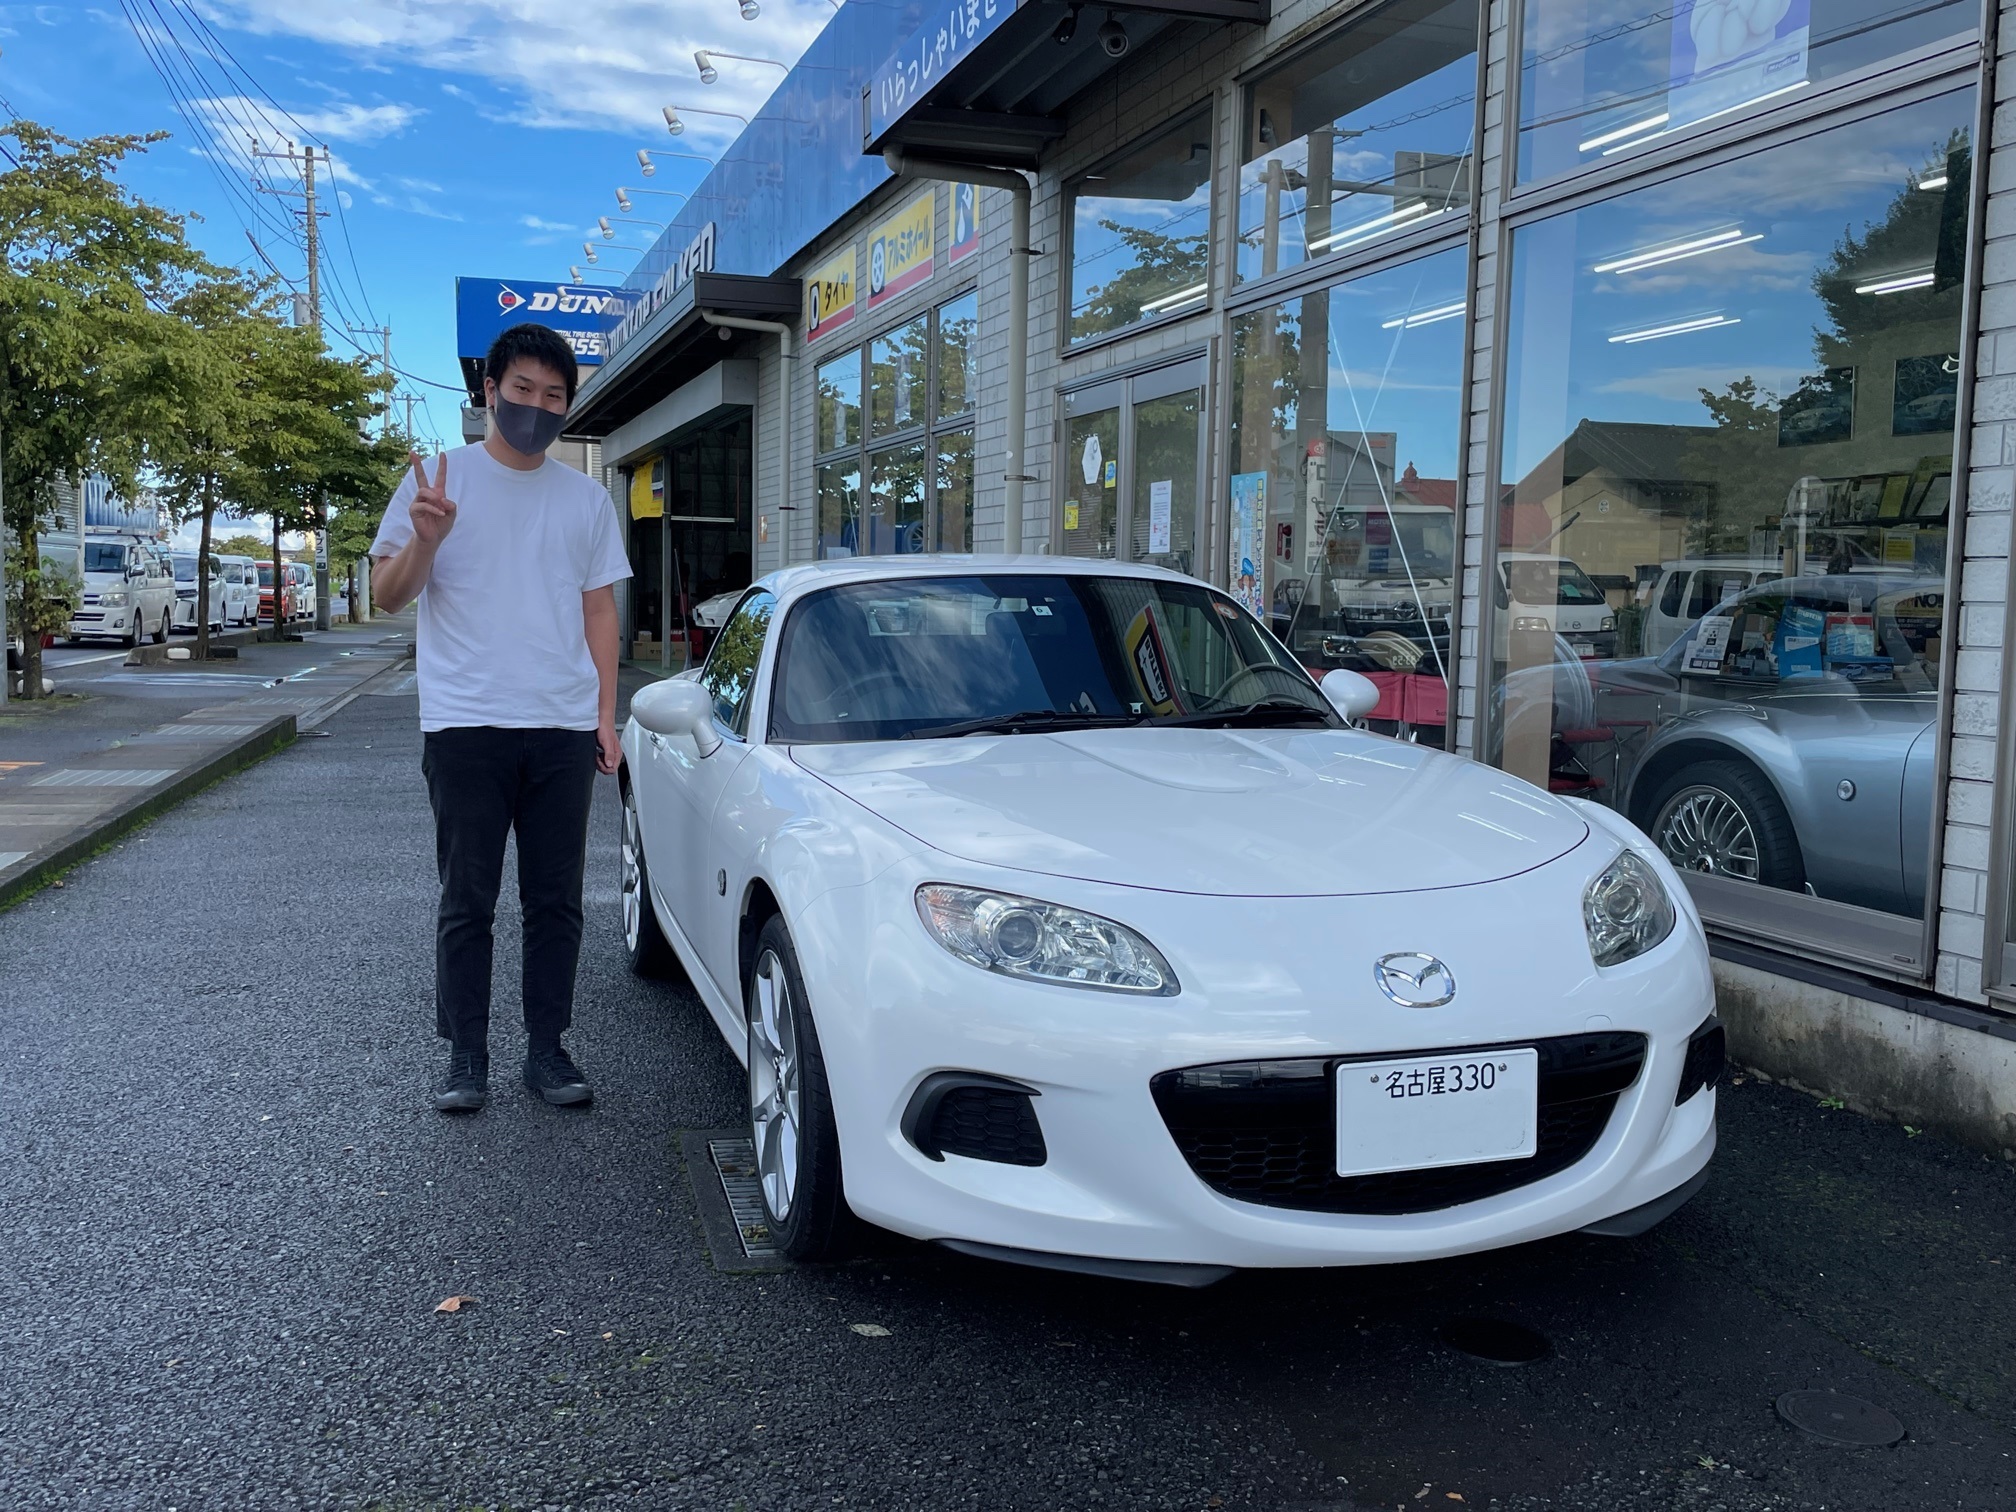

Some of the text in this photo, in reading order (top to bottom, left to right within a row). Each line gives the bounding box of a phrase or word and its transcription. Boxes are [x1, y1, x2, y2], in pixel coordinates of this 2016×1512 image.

[887, 214, 931, 274] アルミホイール
[824, 270, 849, 312] タイヤ
[1385, 1062, 1495, 1098] 名古屋330
